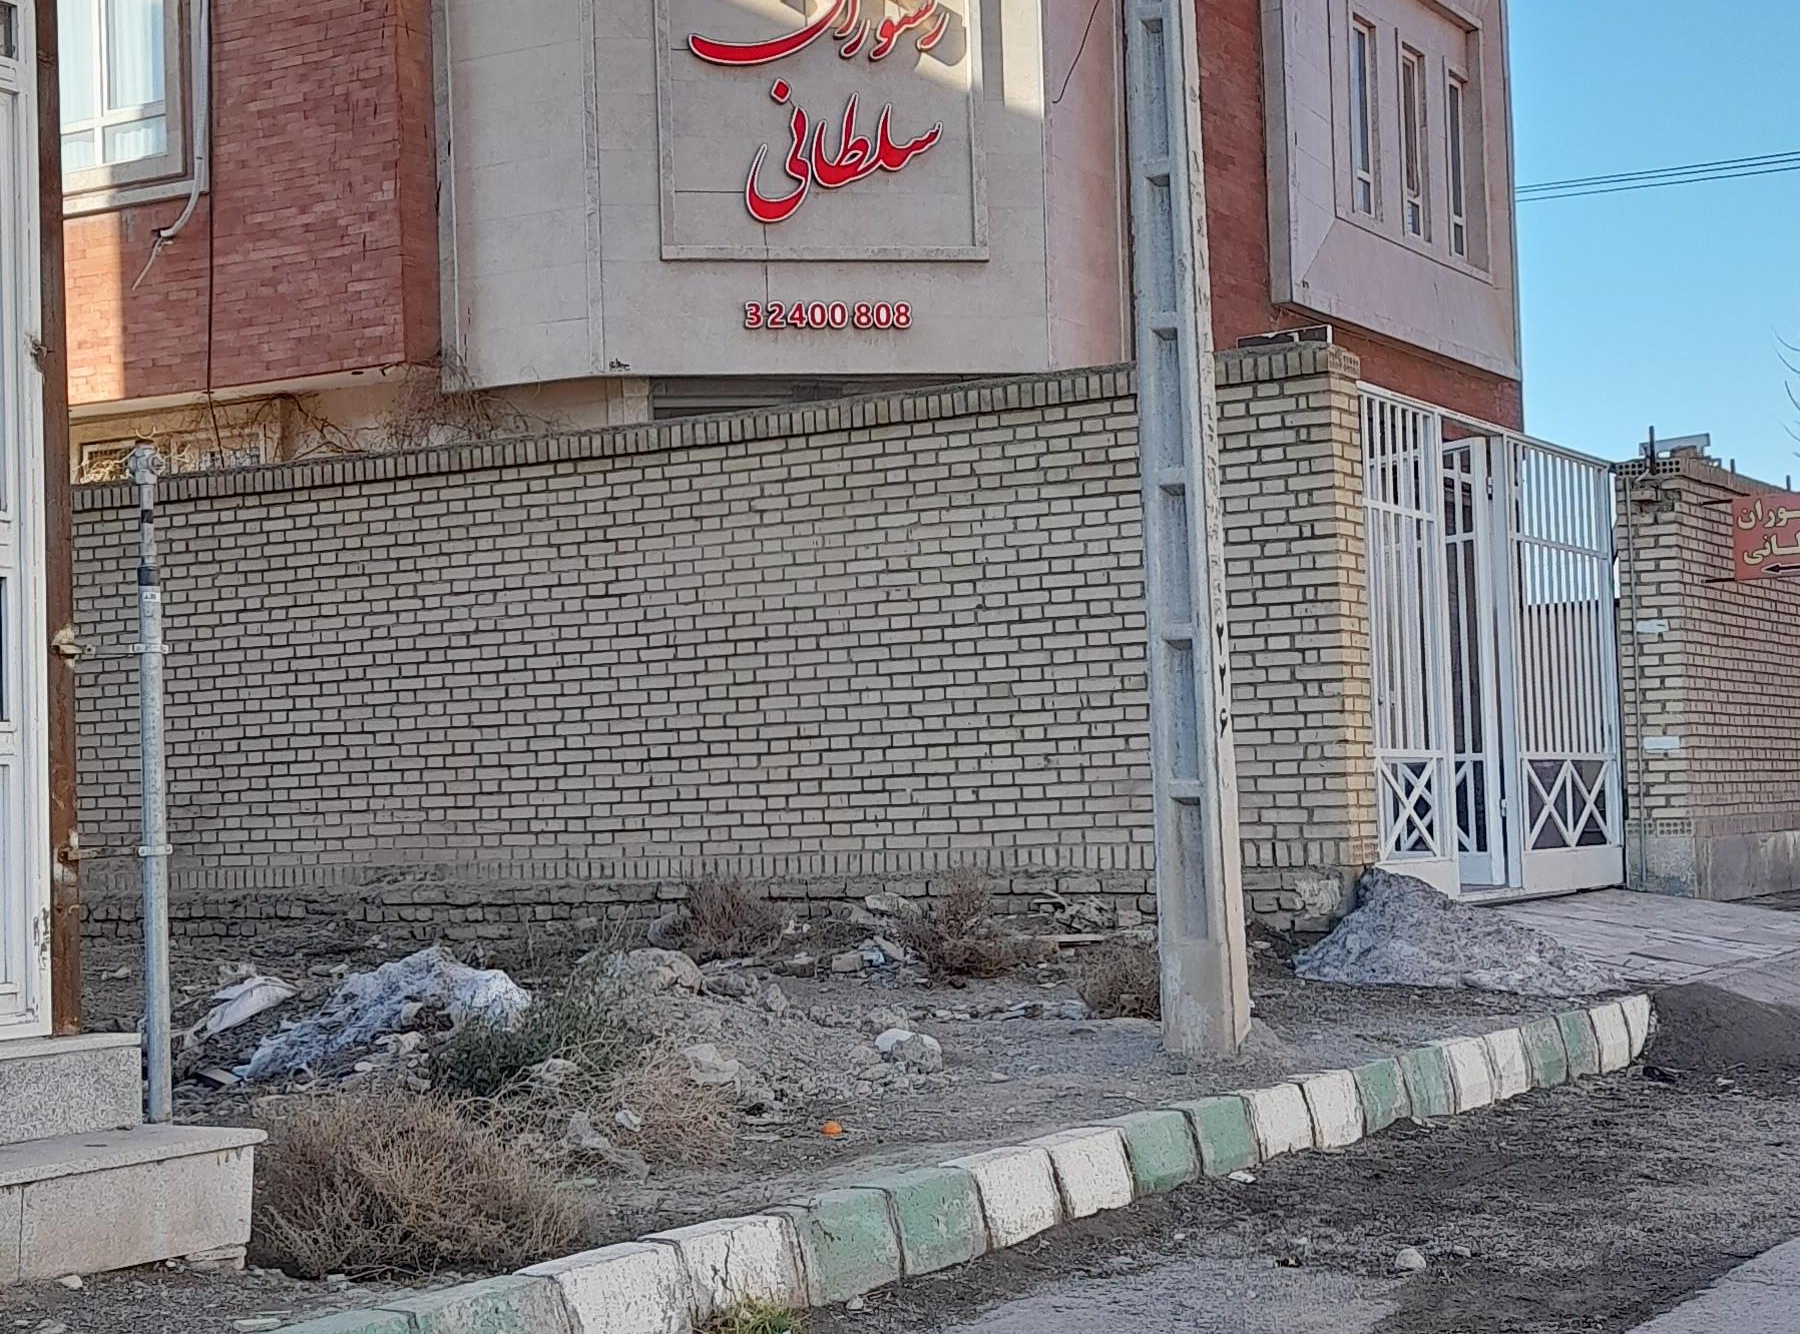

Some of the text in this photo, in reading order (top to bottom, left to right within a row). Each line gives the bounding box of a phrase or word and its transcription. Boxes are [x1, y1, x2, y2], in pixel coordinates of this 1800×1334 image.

[745, 77, 943, 224] سلطانی
[1737, 498, 1800, 530] وران
[1743, 531, 1800, 566] انی
